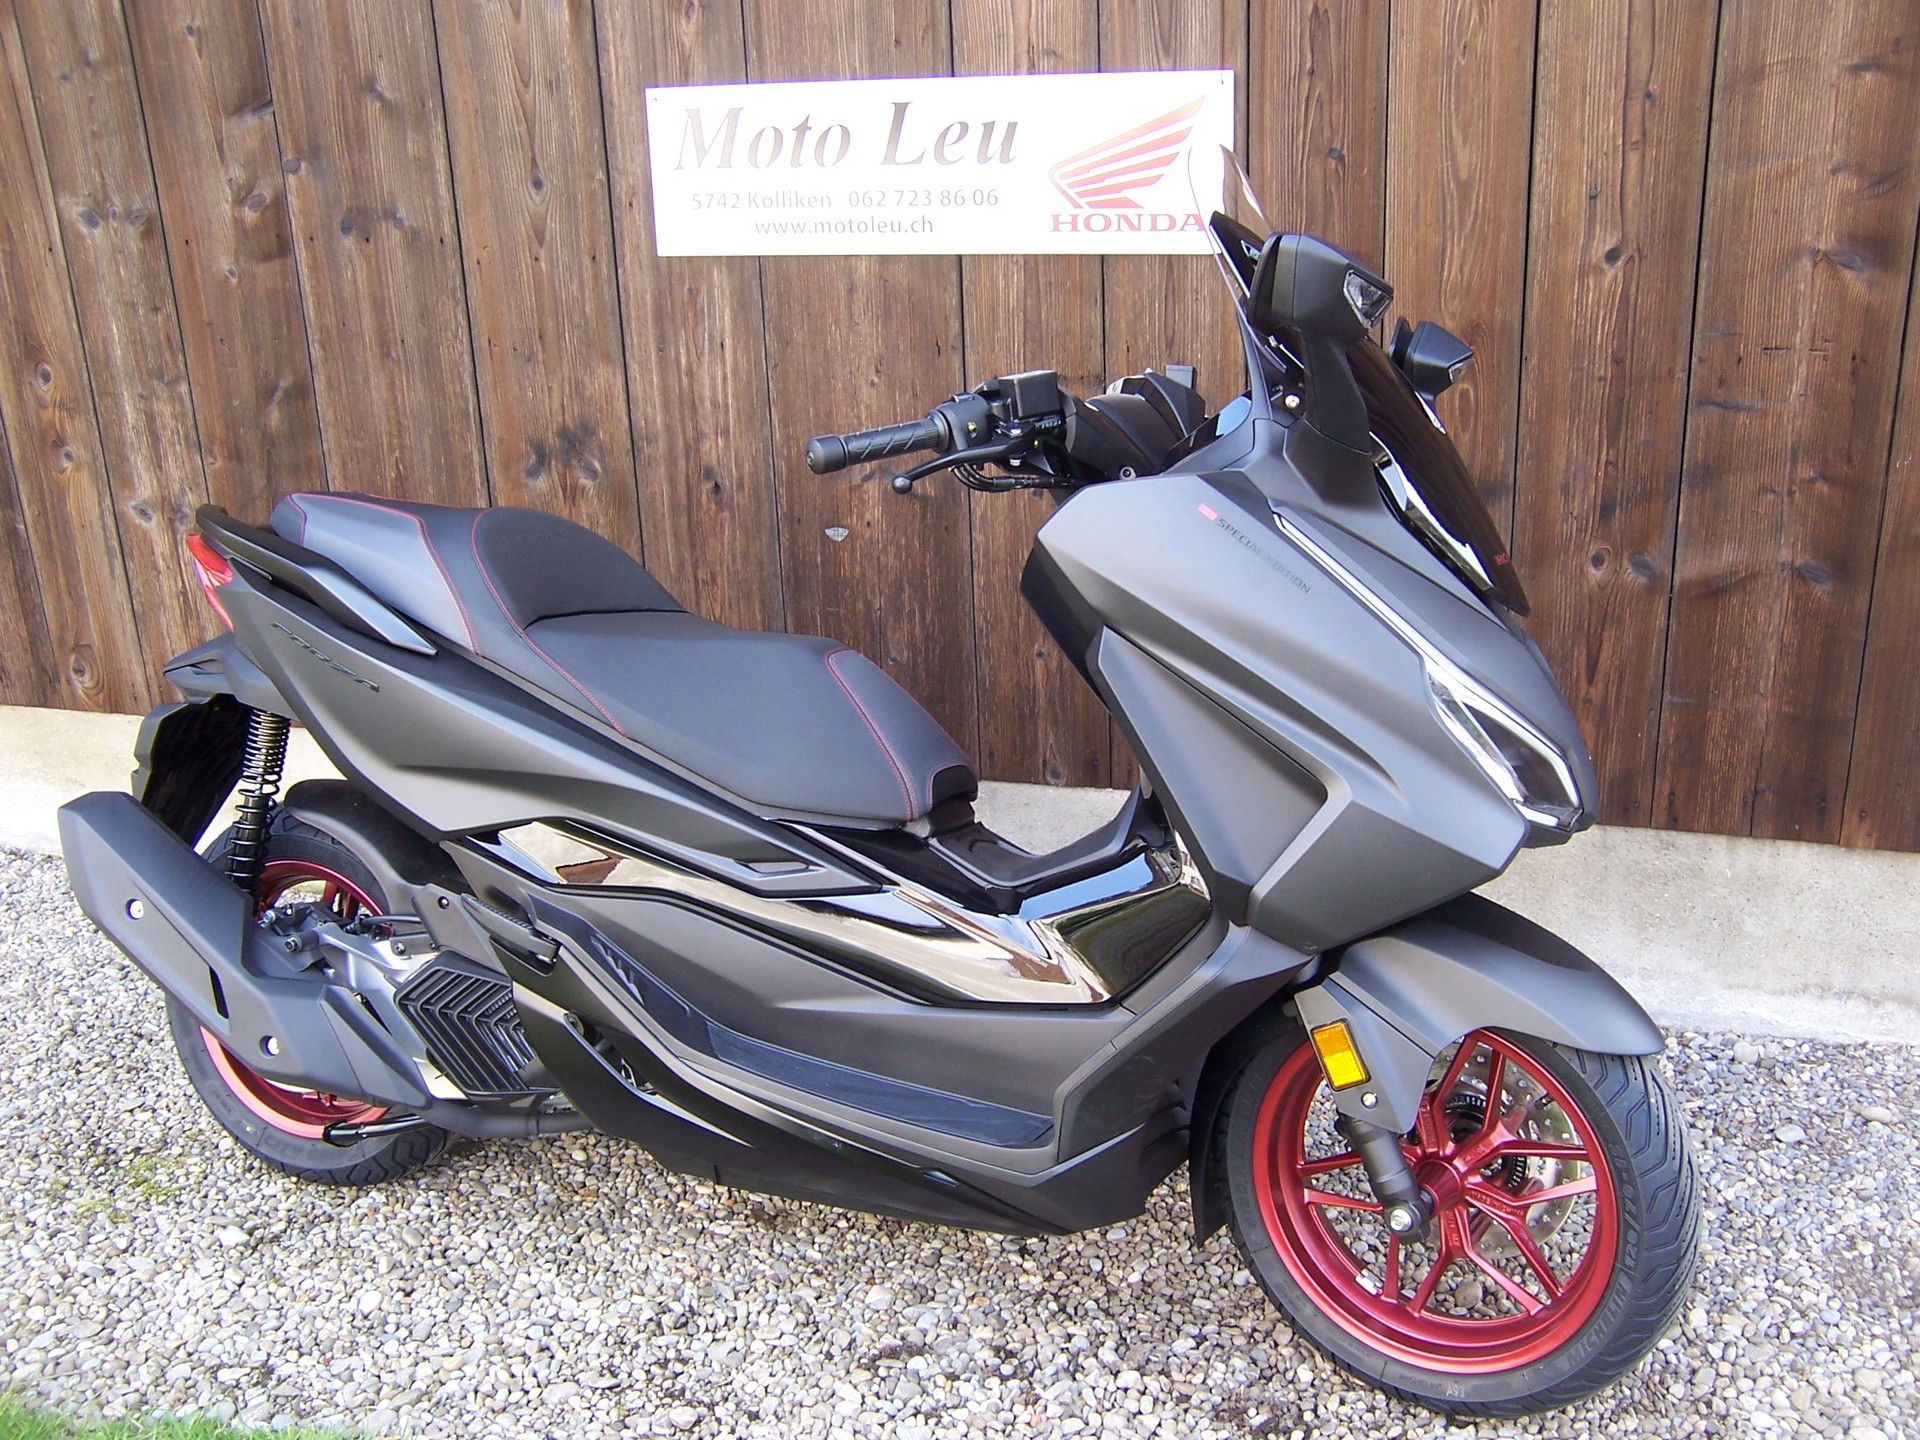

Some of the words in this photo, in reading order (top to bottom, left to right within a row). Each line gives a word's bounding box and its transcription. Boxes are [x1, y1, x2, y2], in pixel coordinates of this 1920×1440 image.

[674, 106, 851, 170] Moto
[880, 100, 1019, 166] Leu
[692, 193, 741, 210] 5742
[848, 190, 887, 207] 062
[894, 189, 932, 207] 723
[940, 189, 966, 206] 86
[973, 188, 999, 206] 06
[755, 214, 934, 235] www.motoleu.ch
[1050, 213, 1207, 233] HONDA
[1566, 1281, 1627, 1369] MICHELIN
